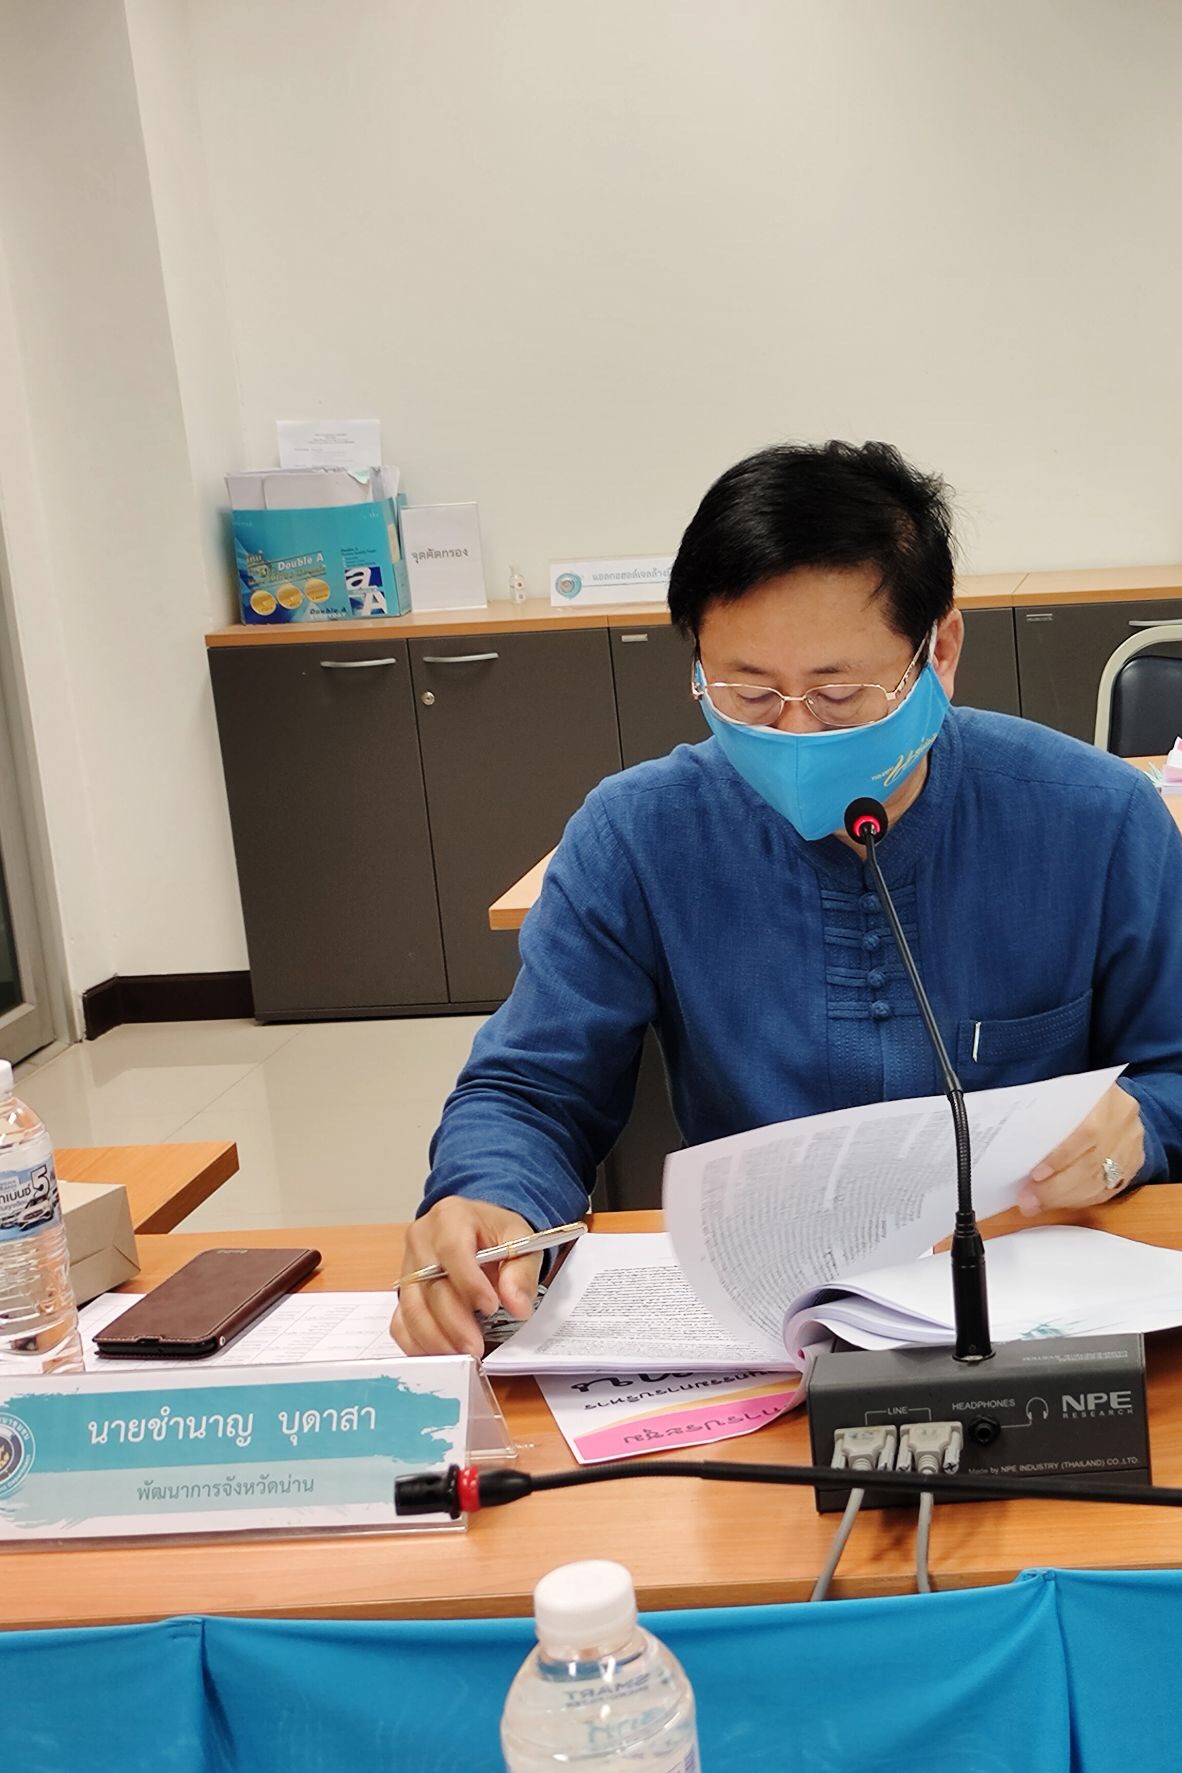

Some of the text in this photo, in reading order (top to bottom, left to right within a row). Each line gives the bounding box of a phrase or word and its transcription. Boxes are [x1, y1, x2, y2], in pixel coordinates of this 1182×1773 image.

[278, 552, 324, 571] Double A
[411, 548, 468, 564] จุดคัดกรอง
[592, 567, 671, 581] แอลกอฮอล์เจลล้าง
[31, 1164, 50, 1199] 5
[952, 1398, 1016, 1411] HEADPHONES
[1062, 1390, 1133, 1412] NPE
[887, 1406, 908, 1415] LINE
[1062, 1409, 1134, 1419] RESEARCH
[88, 1404, 377, 1448] นายชำนาญ บุดาสา
[1001, 1464, 1017, 1473] NPE
[1019, 1462, 1059, 1472] INDUSTRY
[1061, 1459, 1105, 1471] (THAILAND)
[137, 1473, 315, 1501] พัฒนาการจังหวัดน่าน
